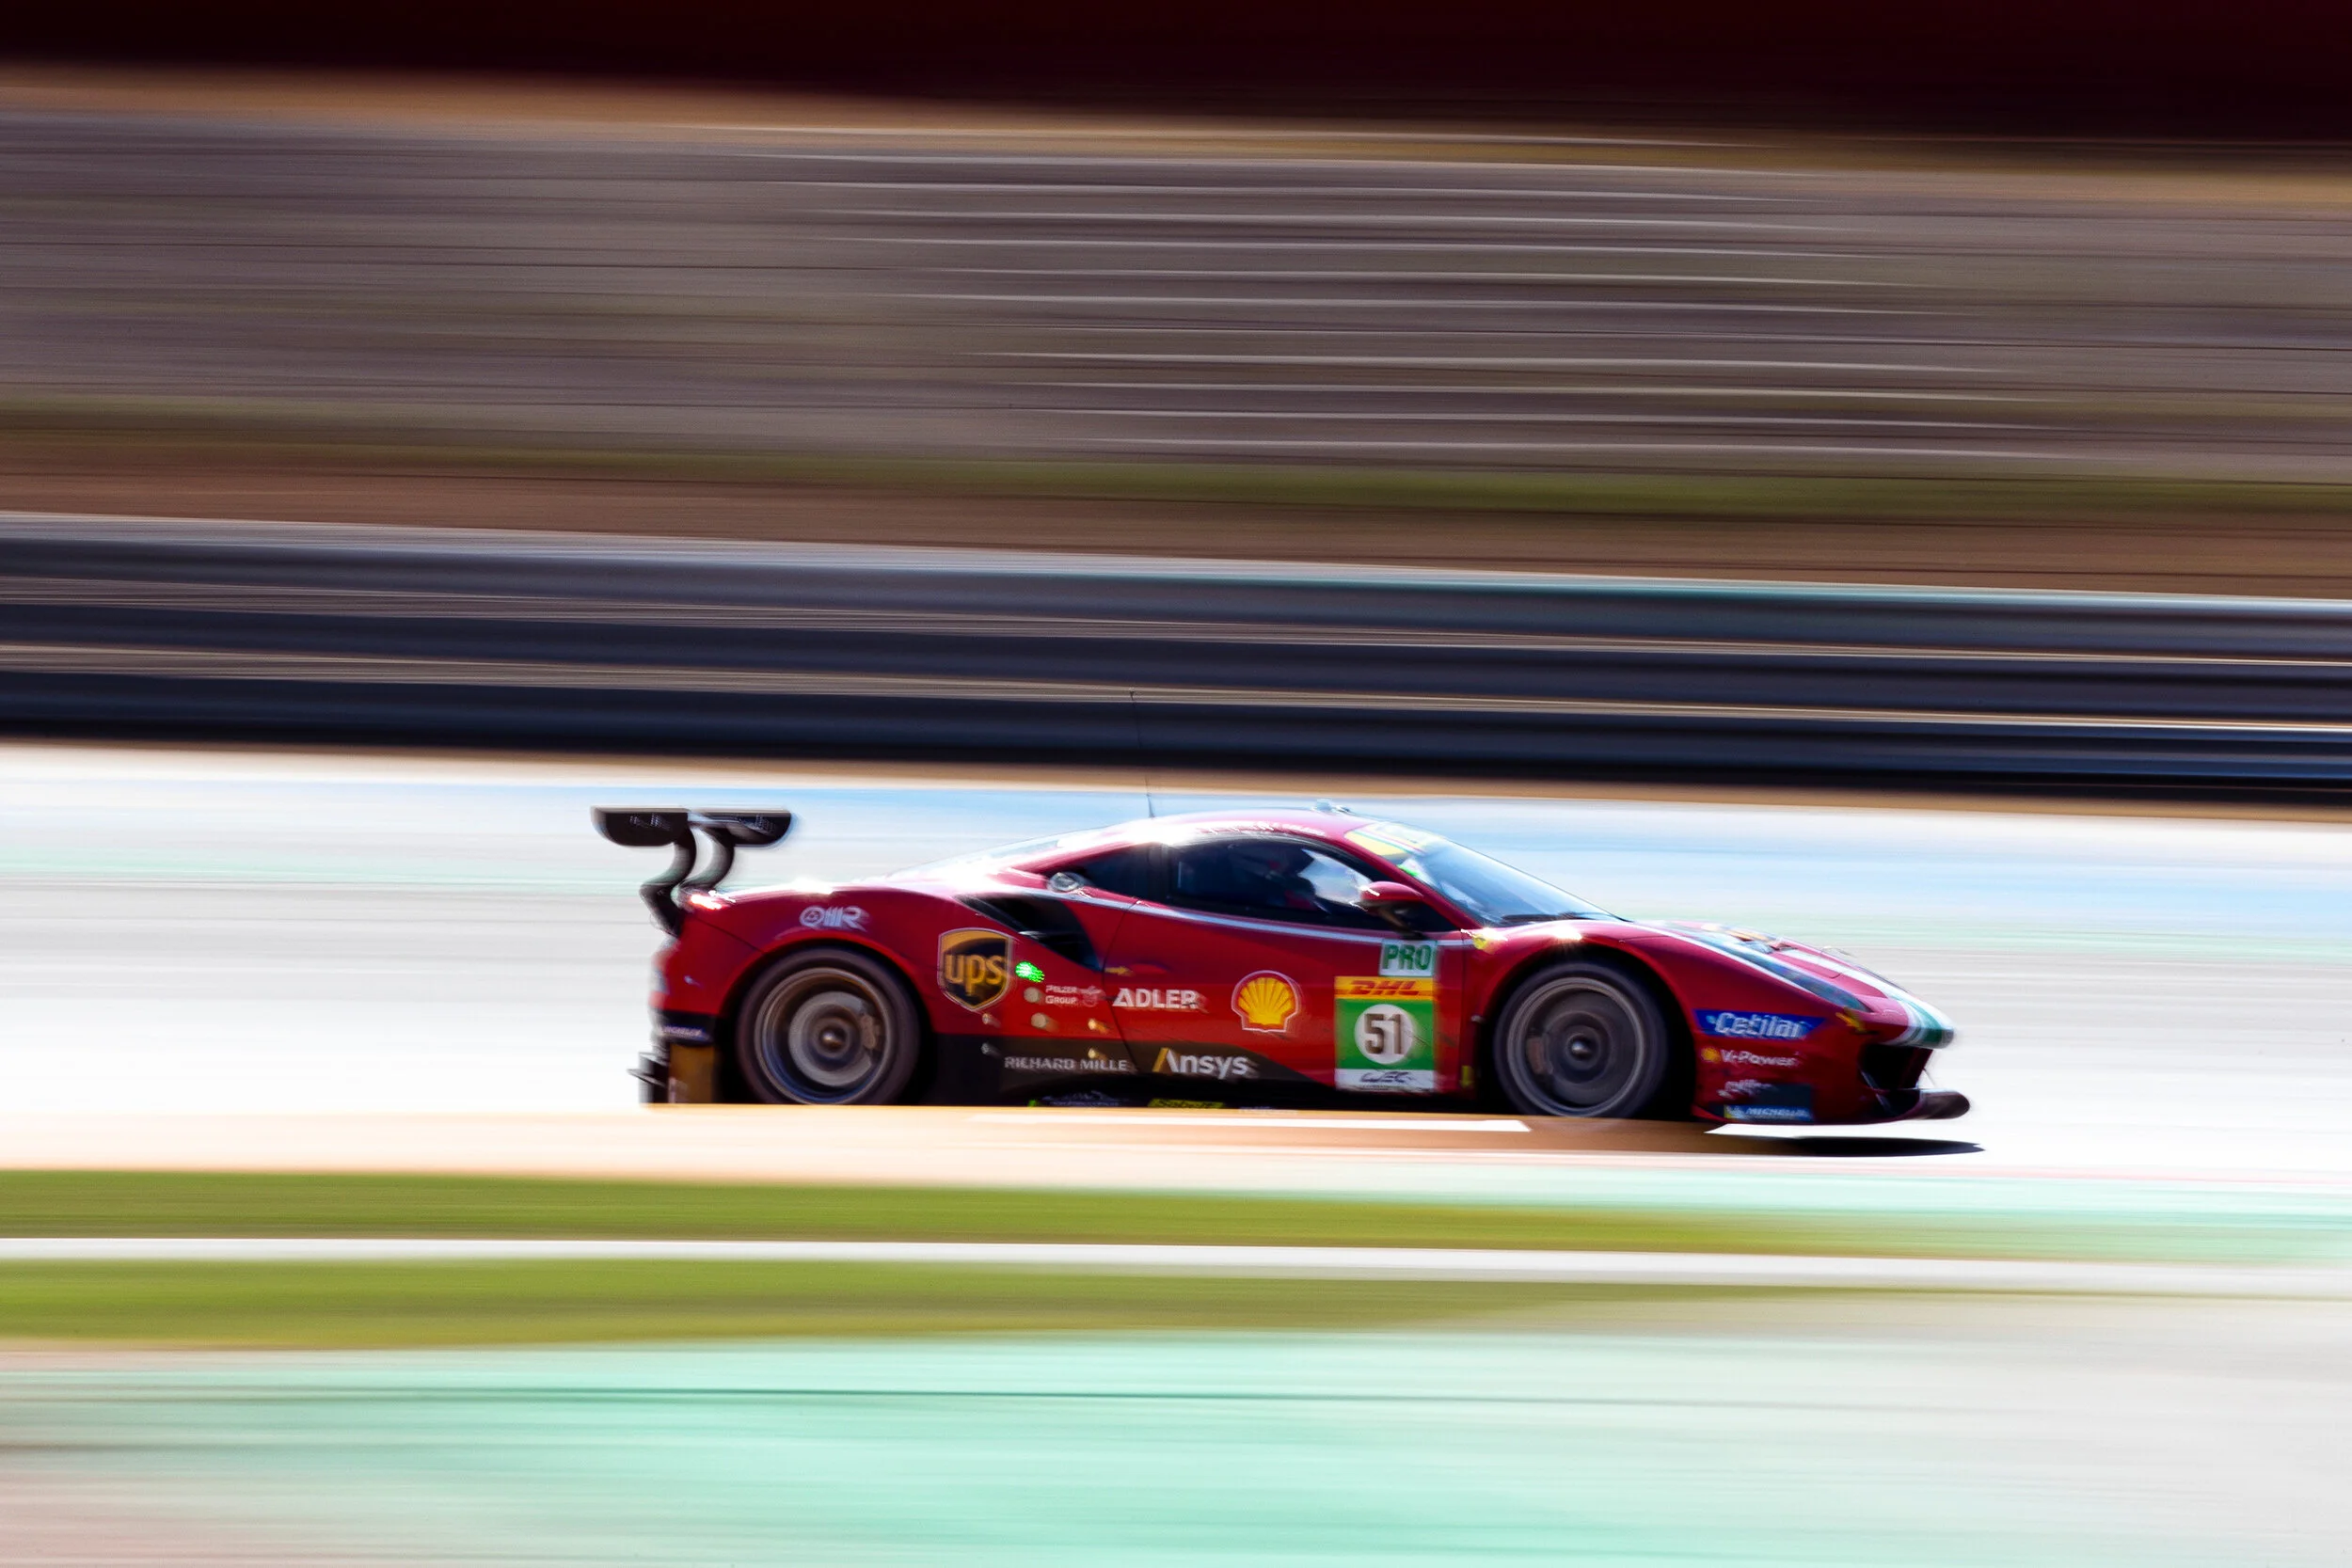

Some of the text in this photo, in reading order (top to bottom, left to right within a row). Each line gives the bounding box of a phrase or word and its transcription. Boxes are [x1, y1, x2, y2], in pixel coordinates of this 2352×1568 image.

[1382, 944, 1431, 970] PRO
[945, 954, 1005, 995] ups
[1349, 980, 1419, 995] DHL
[1112, 988, 1199, 1009] ADLER
[1365, 1013, 1403, 1054] 51
[1080, 1059, 1129, 1071] MILLE
[1152, 1047, 1250, 1080] Ansys
